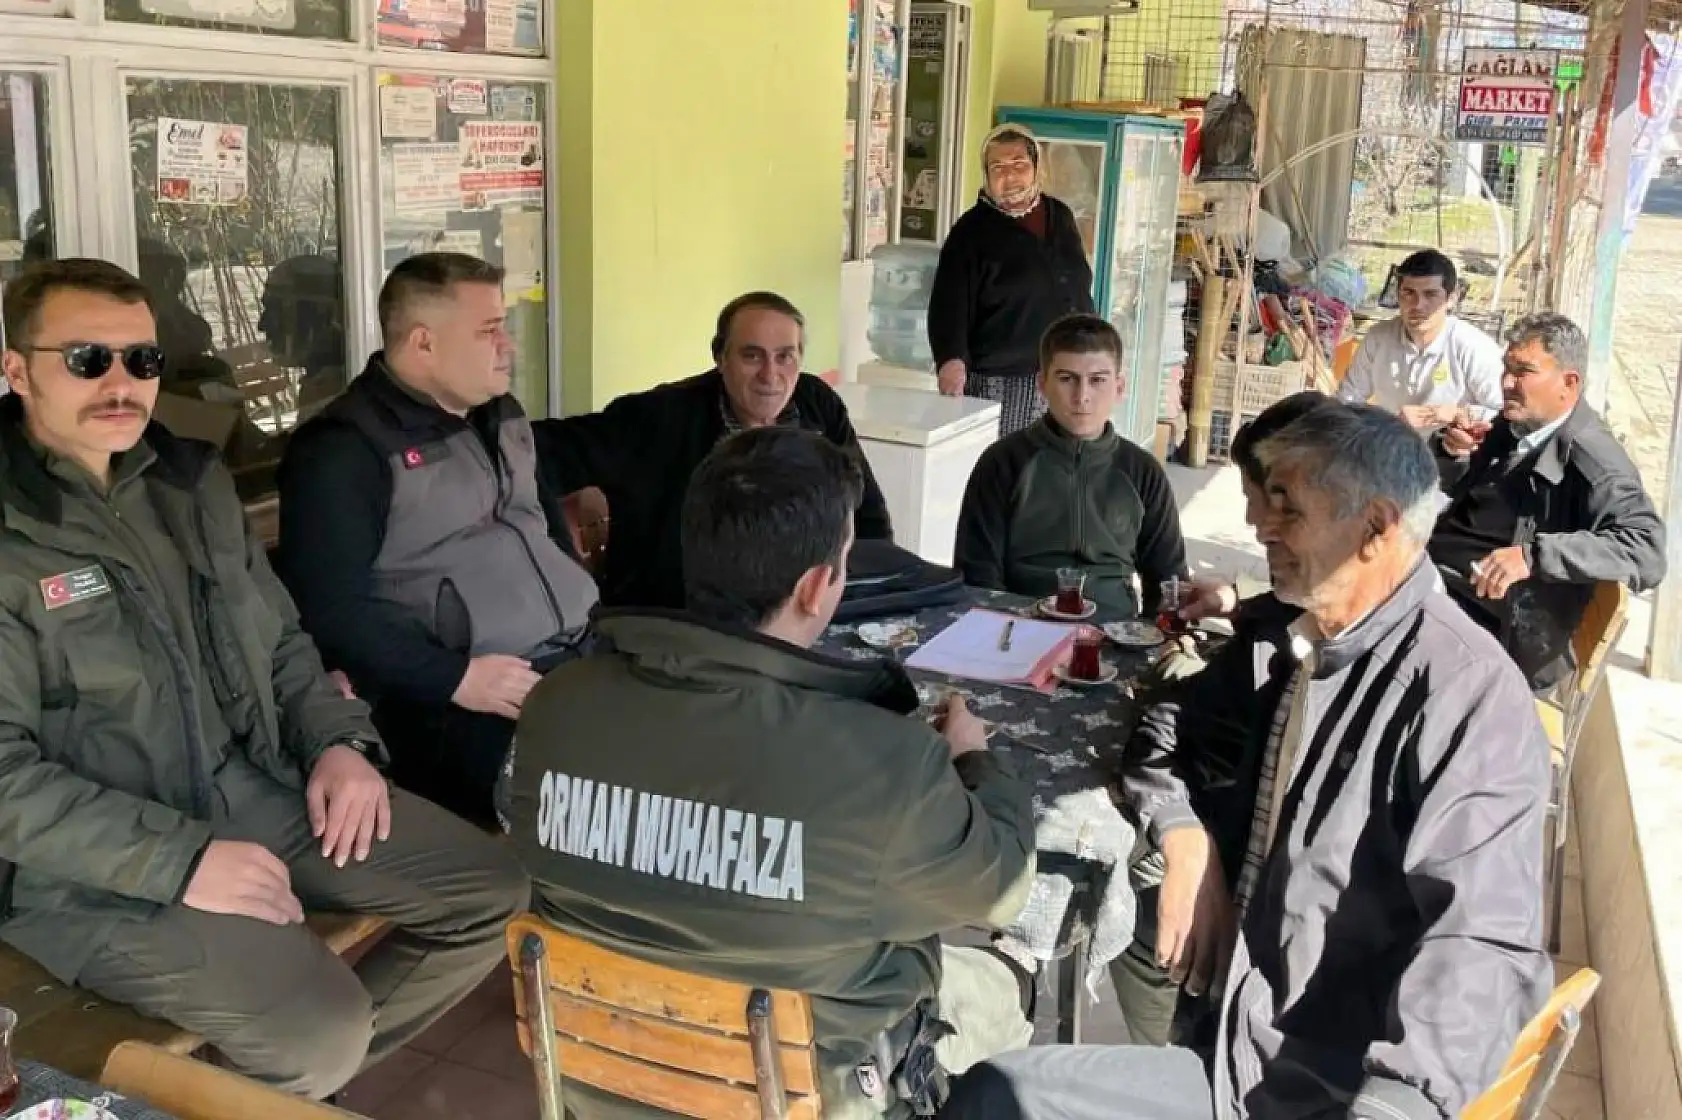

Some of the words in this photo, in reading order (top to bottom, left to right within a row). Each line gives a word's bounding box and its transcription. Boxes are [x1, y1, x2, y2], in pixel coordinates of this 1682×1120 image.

[1464, 88, 1551, 112] MARKET
[538, 769, 633, 867] ORMAN
[631, 791, 804, 901] MUHAFAZA
